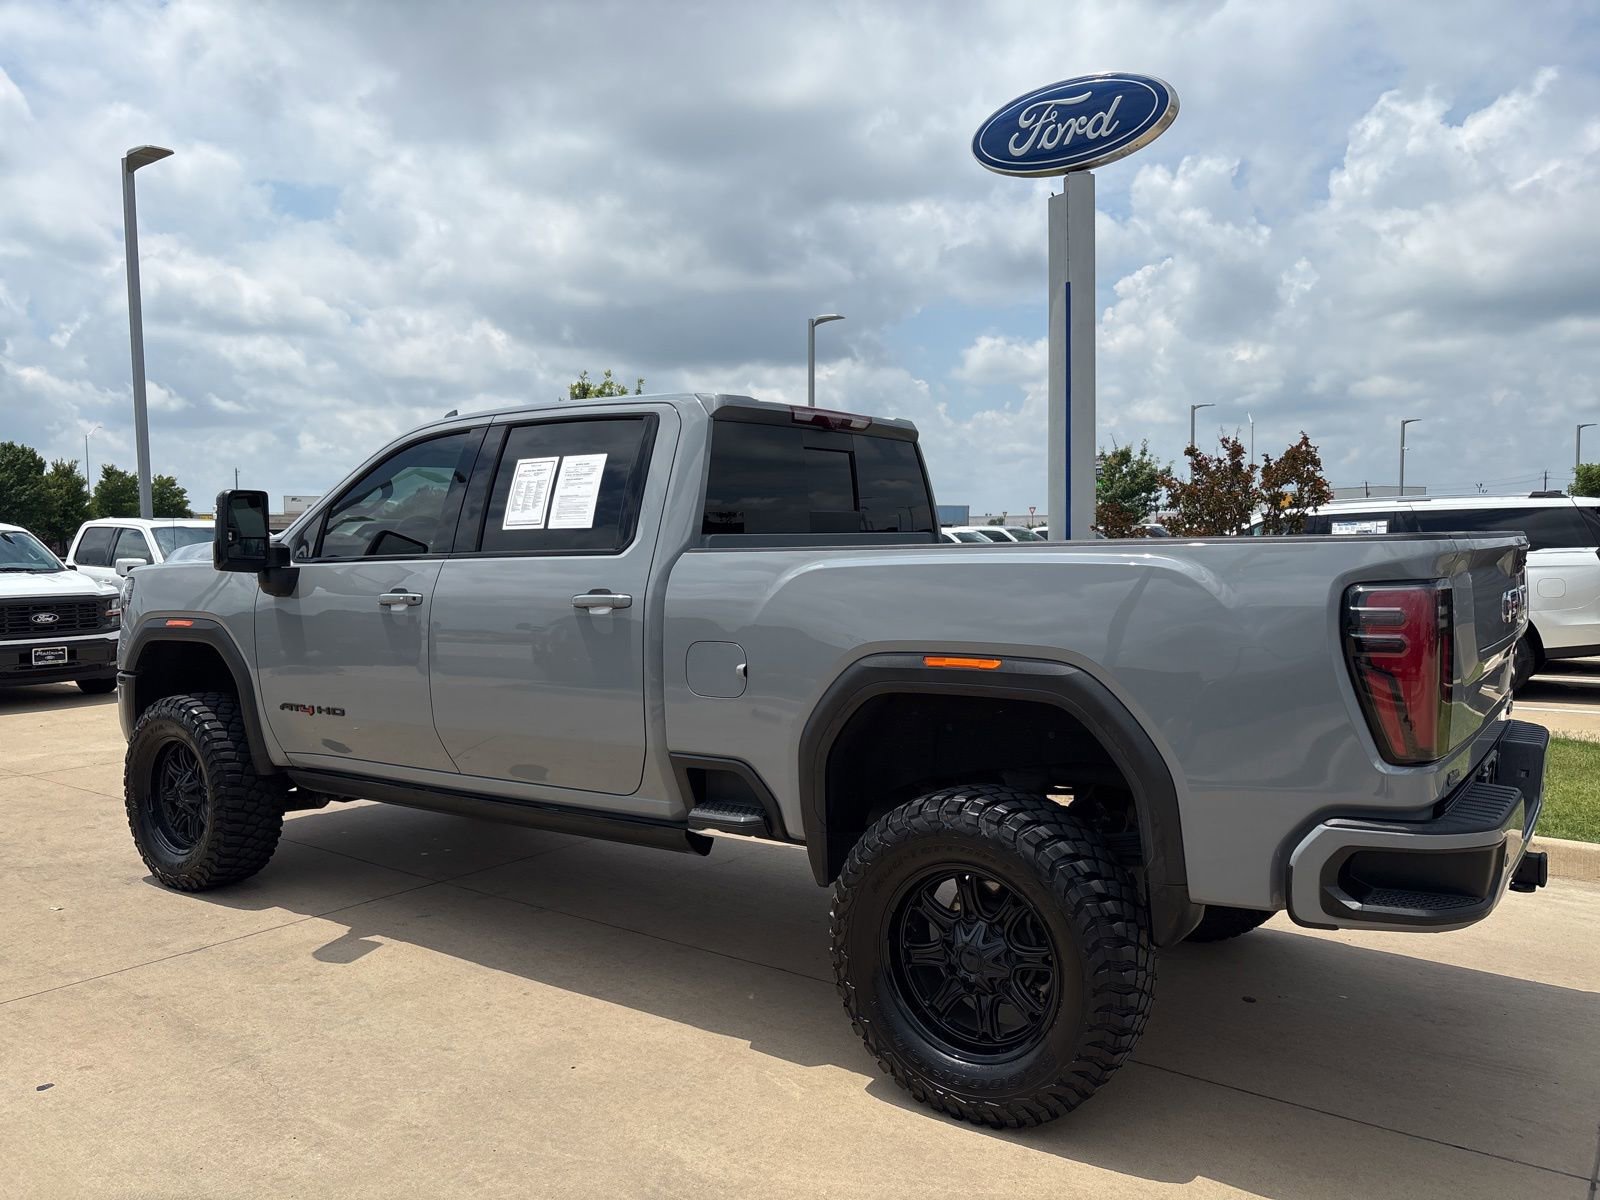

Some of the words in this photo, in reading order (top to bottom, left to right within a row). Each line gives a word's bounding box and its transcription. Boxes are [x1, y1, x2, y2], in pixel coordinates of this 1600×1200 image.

[1008, 90, 1123, 157] Ford
[36, 614, 54, 622] Ford
[279, 702, 315, 716] AT4
[316, 705, 345, 717] HD
